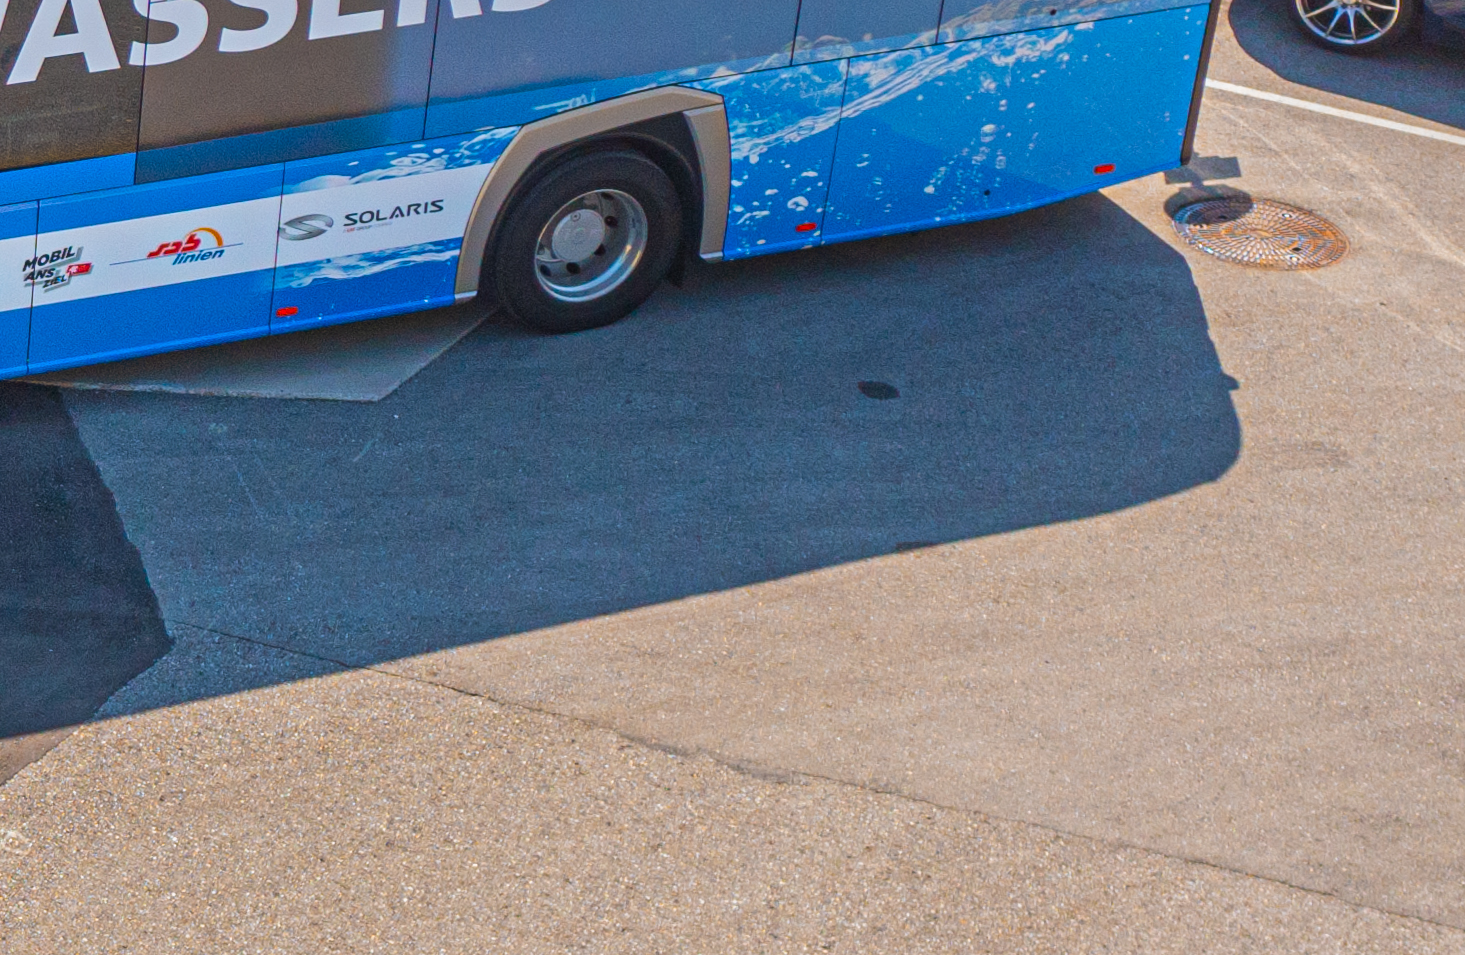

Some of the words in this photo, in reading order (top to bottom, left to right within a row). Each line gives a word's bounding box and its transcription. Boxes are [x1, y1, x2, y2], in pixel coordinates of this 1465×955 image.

[343, 199, 445, 227] SOLARIS
[22, 245, 76, 272] MOBIL
[172, 249, 226, 265] linien
[23, 267, 56, 282] ANS
[42, 274, 68, 288] ZIEL
